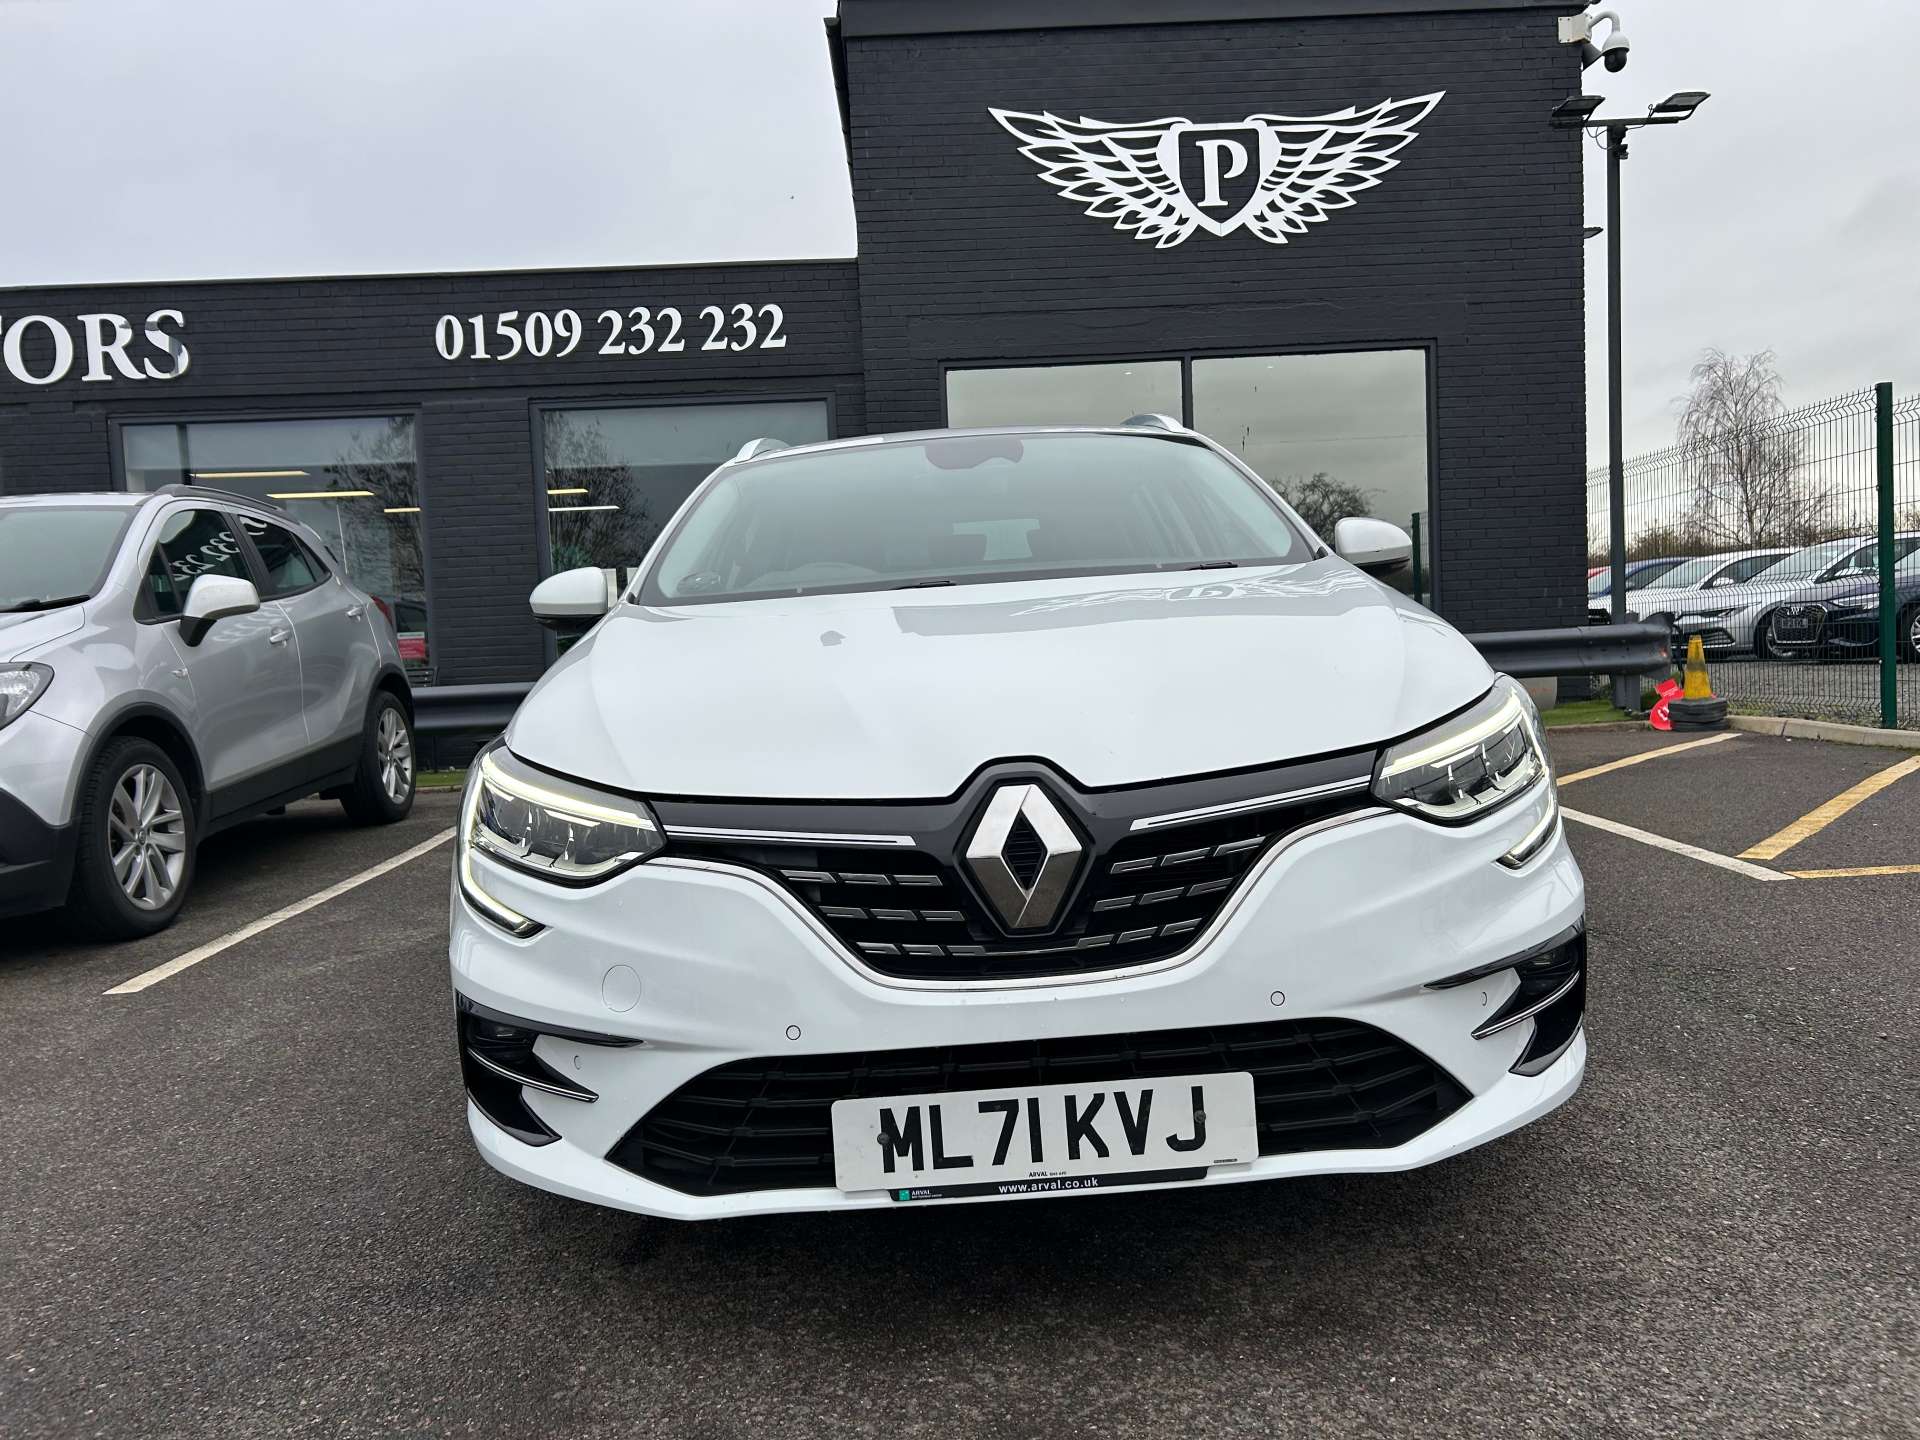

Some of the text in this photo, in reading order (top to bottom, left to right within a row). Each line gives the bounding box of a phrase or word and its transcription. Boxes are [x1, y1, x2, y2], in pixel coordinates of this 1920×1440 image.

[1195, 139, 1248, 207] P
[0, 309, 190, 385] ORS
[435, 303, 787, 361] 01509 232 232
[879, 1086, 1207, 1174] ML71 KVJ
[998, 1177, 1099, 1194] www.arval.co.uk
